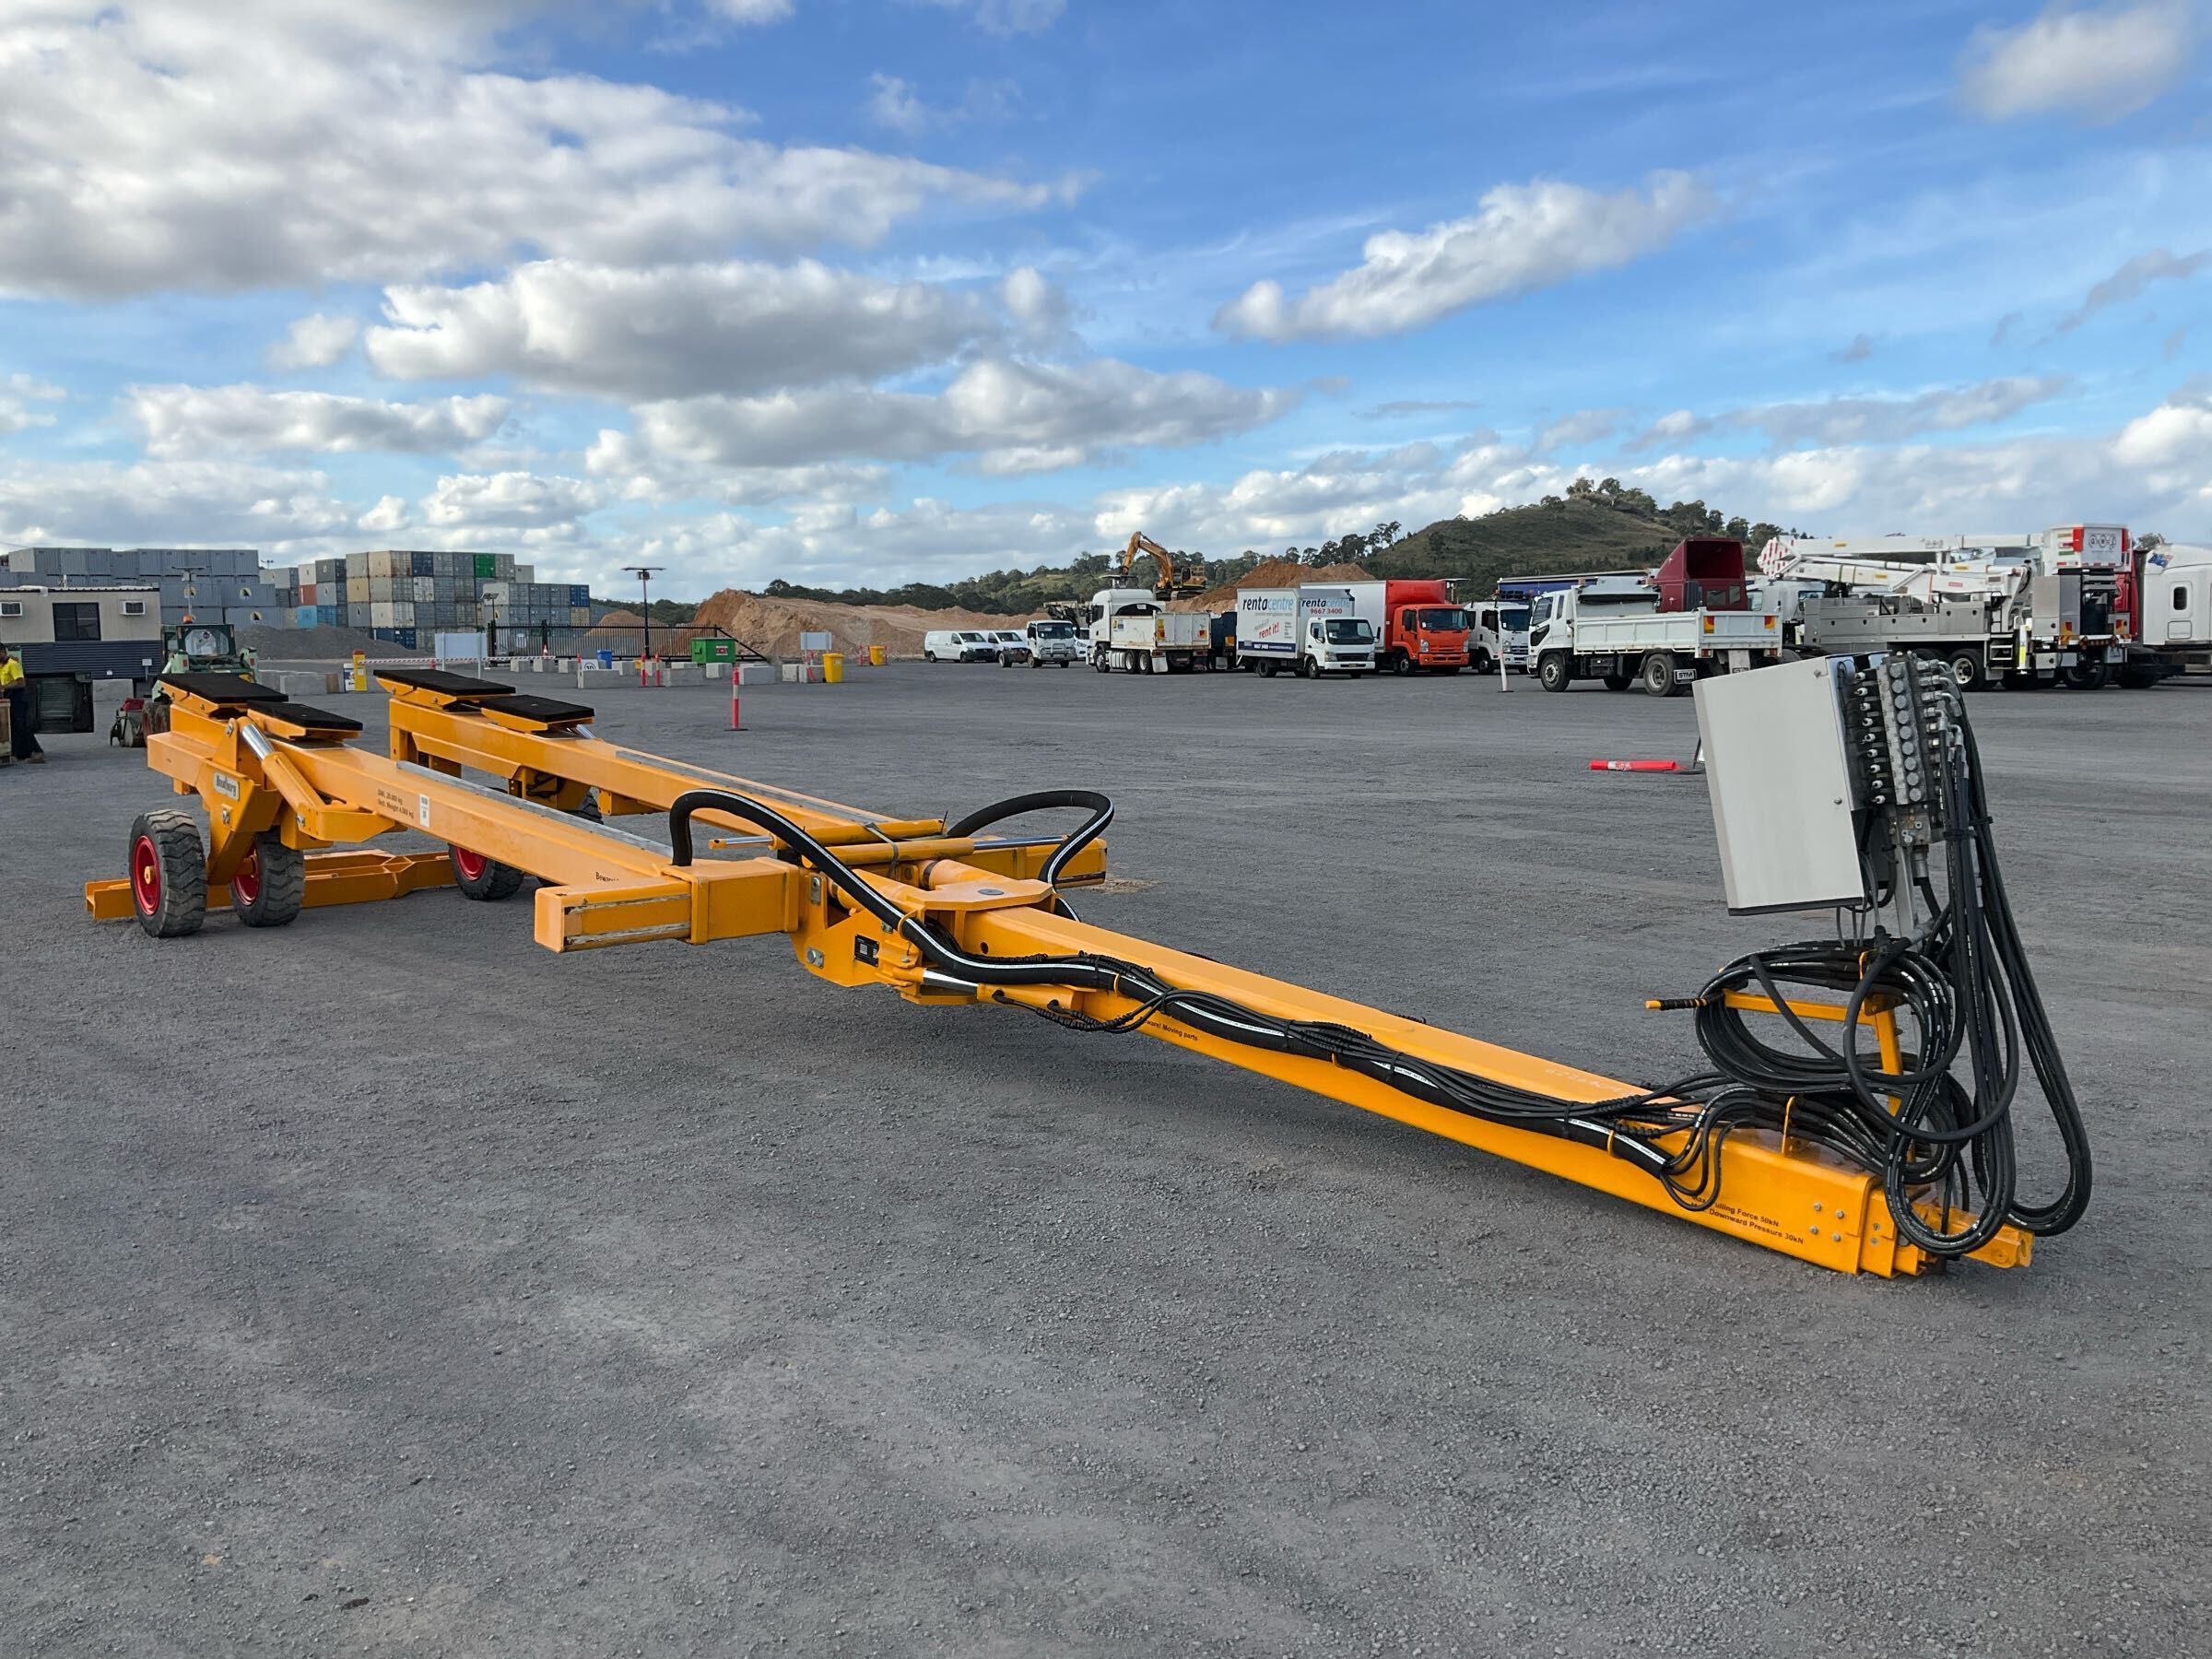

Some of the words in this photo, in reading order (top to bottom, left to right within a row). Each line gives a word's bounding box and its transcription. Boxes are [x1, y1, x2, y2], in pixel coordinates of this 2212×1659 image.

[1242, 596, 1294, 610] rentacentre
[1258, 626, 1271, 639] rent
[1162, 1024, 1183, 1037] Moving
[1183, 1032, 1198, 1041] parts
[1714, 1202, 1735, 1215] ulling
[1737, 1208, 1759, 1221] Force
[1759, 1216, 1779, 1228] 50kN
[1709, 1207, 1747, 1227] Downward
[1749, 1220, 1783, 1238] Pressure
[1784, 1232, 1804, 1244] 30kN
